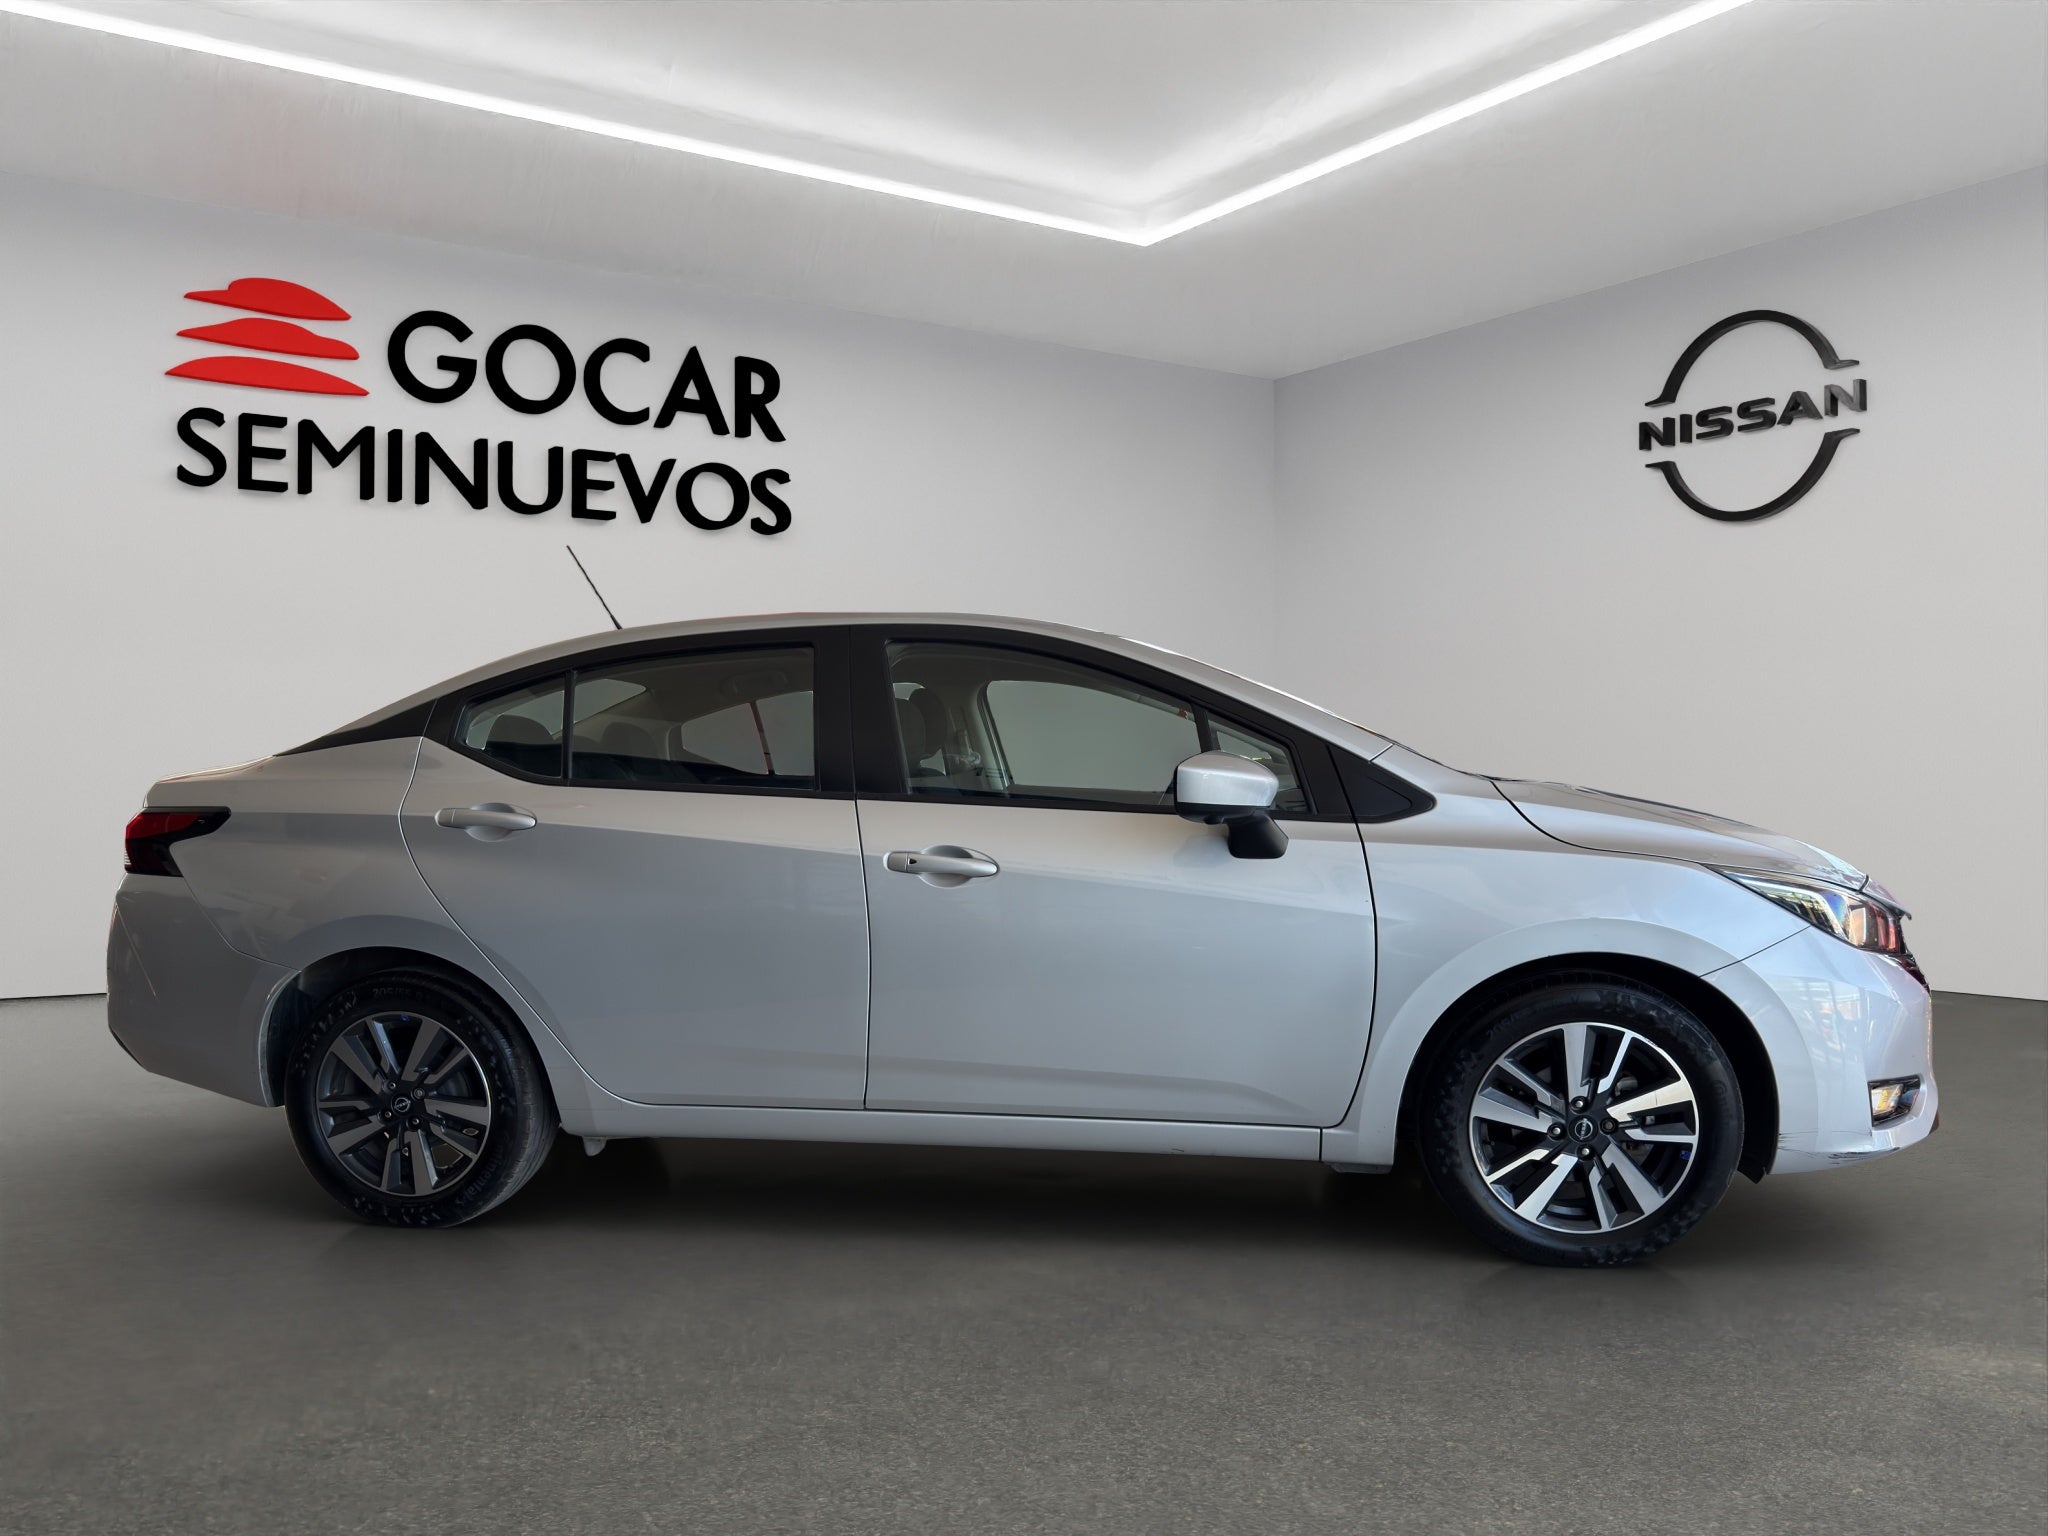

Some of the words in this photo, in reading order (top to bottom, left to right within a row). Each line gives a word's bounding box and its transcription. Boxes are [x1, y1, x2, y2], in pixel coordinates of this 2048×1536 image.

[388, 311, 787, 442] GOCAR
[1639, 379, 1867, 451] NISSAN
[176, 407, 792, 536] SEMINUEVOS
